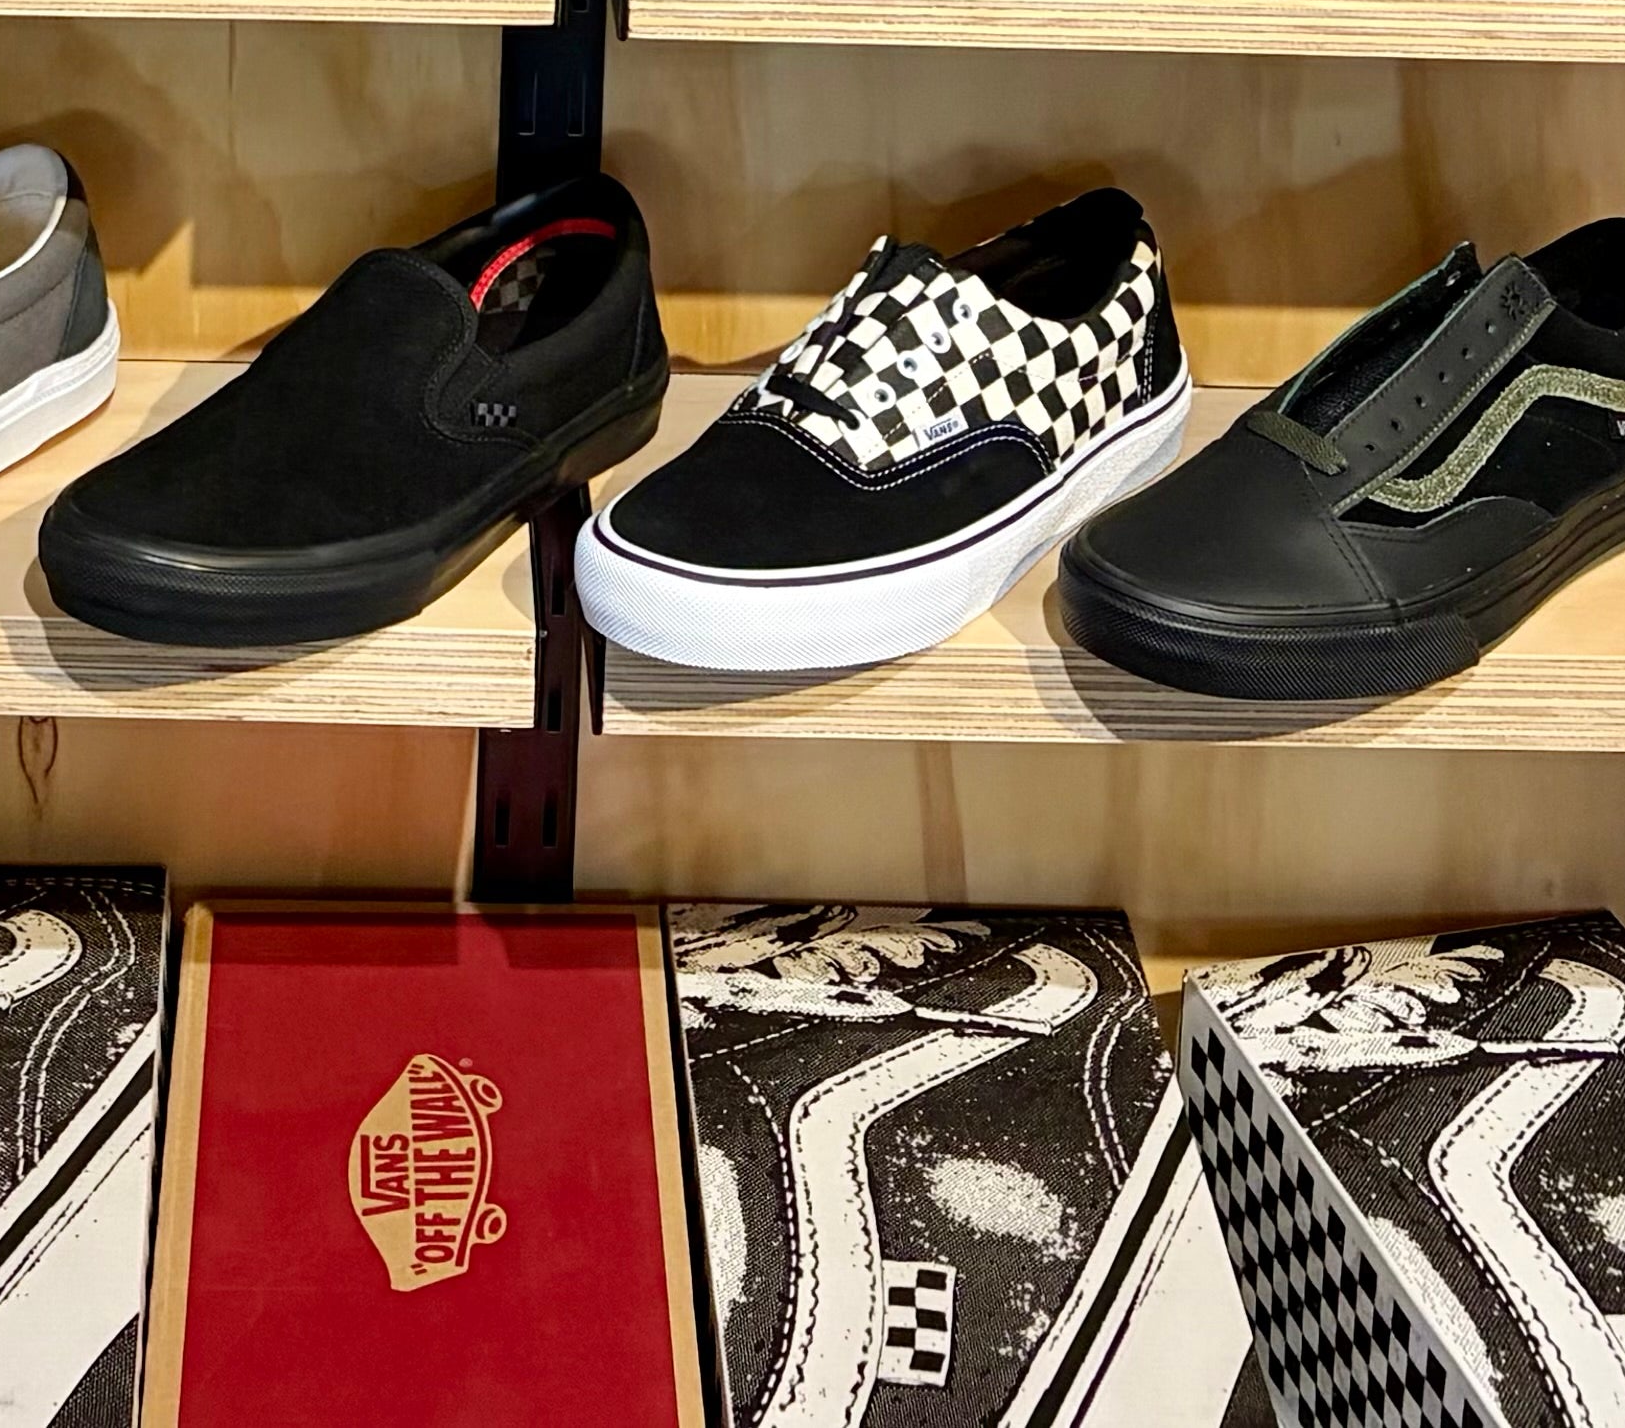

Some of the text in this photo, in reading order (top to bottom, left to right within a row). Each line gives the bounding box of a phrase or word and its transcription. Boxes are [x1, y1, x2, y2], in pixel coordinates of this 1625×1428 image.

[923, 419, 953, 441] VANS
[360, 1133, 411, 1217] VANS
[413, 1146, 476, 1206] THE
